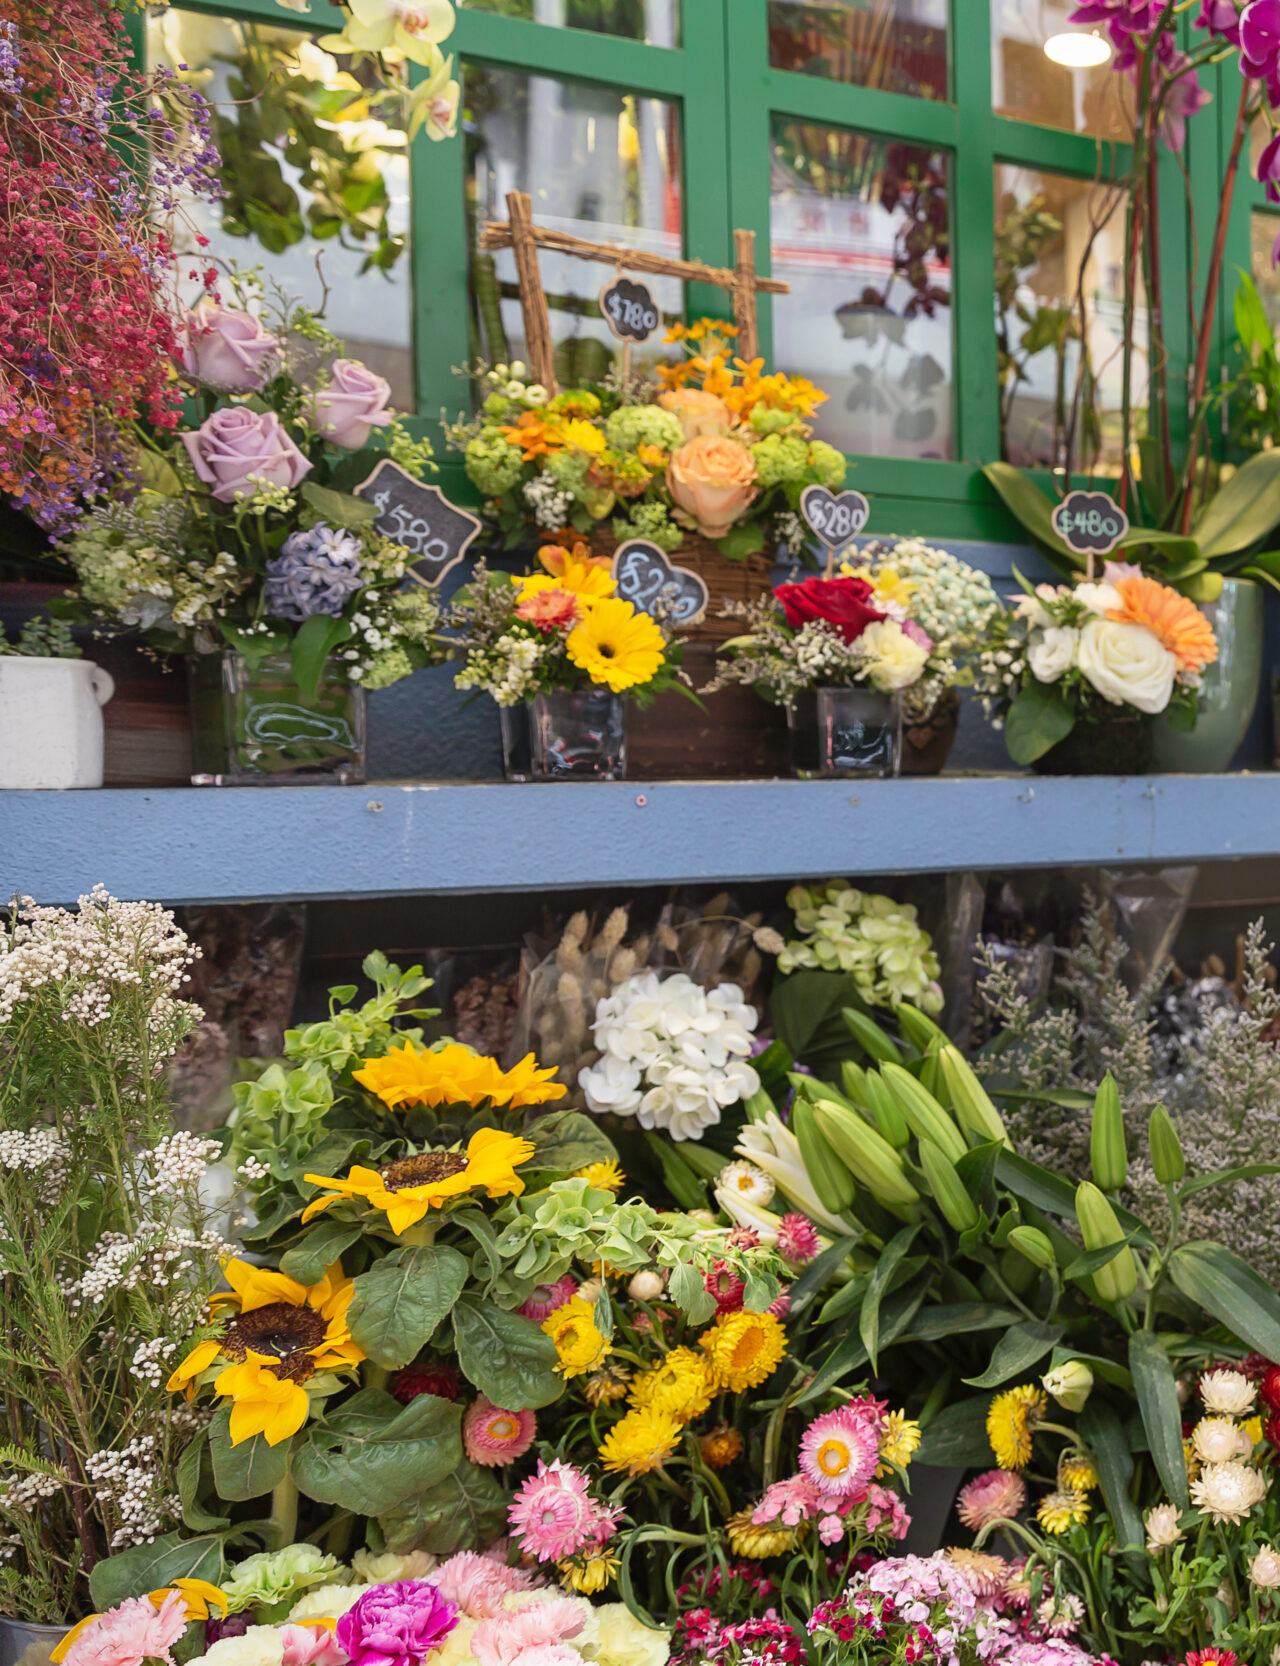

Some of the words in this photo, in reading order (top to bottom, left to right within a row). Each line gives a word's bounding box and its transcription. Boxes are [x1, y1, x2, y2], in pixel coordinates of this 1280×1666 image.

[374, 490, 449, 561] $580
[808, 499, 865, 537] $280
[1058, 508, 1118, 537] $480
